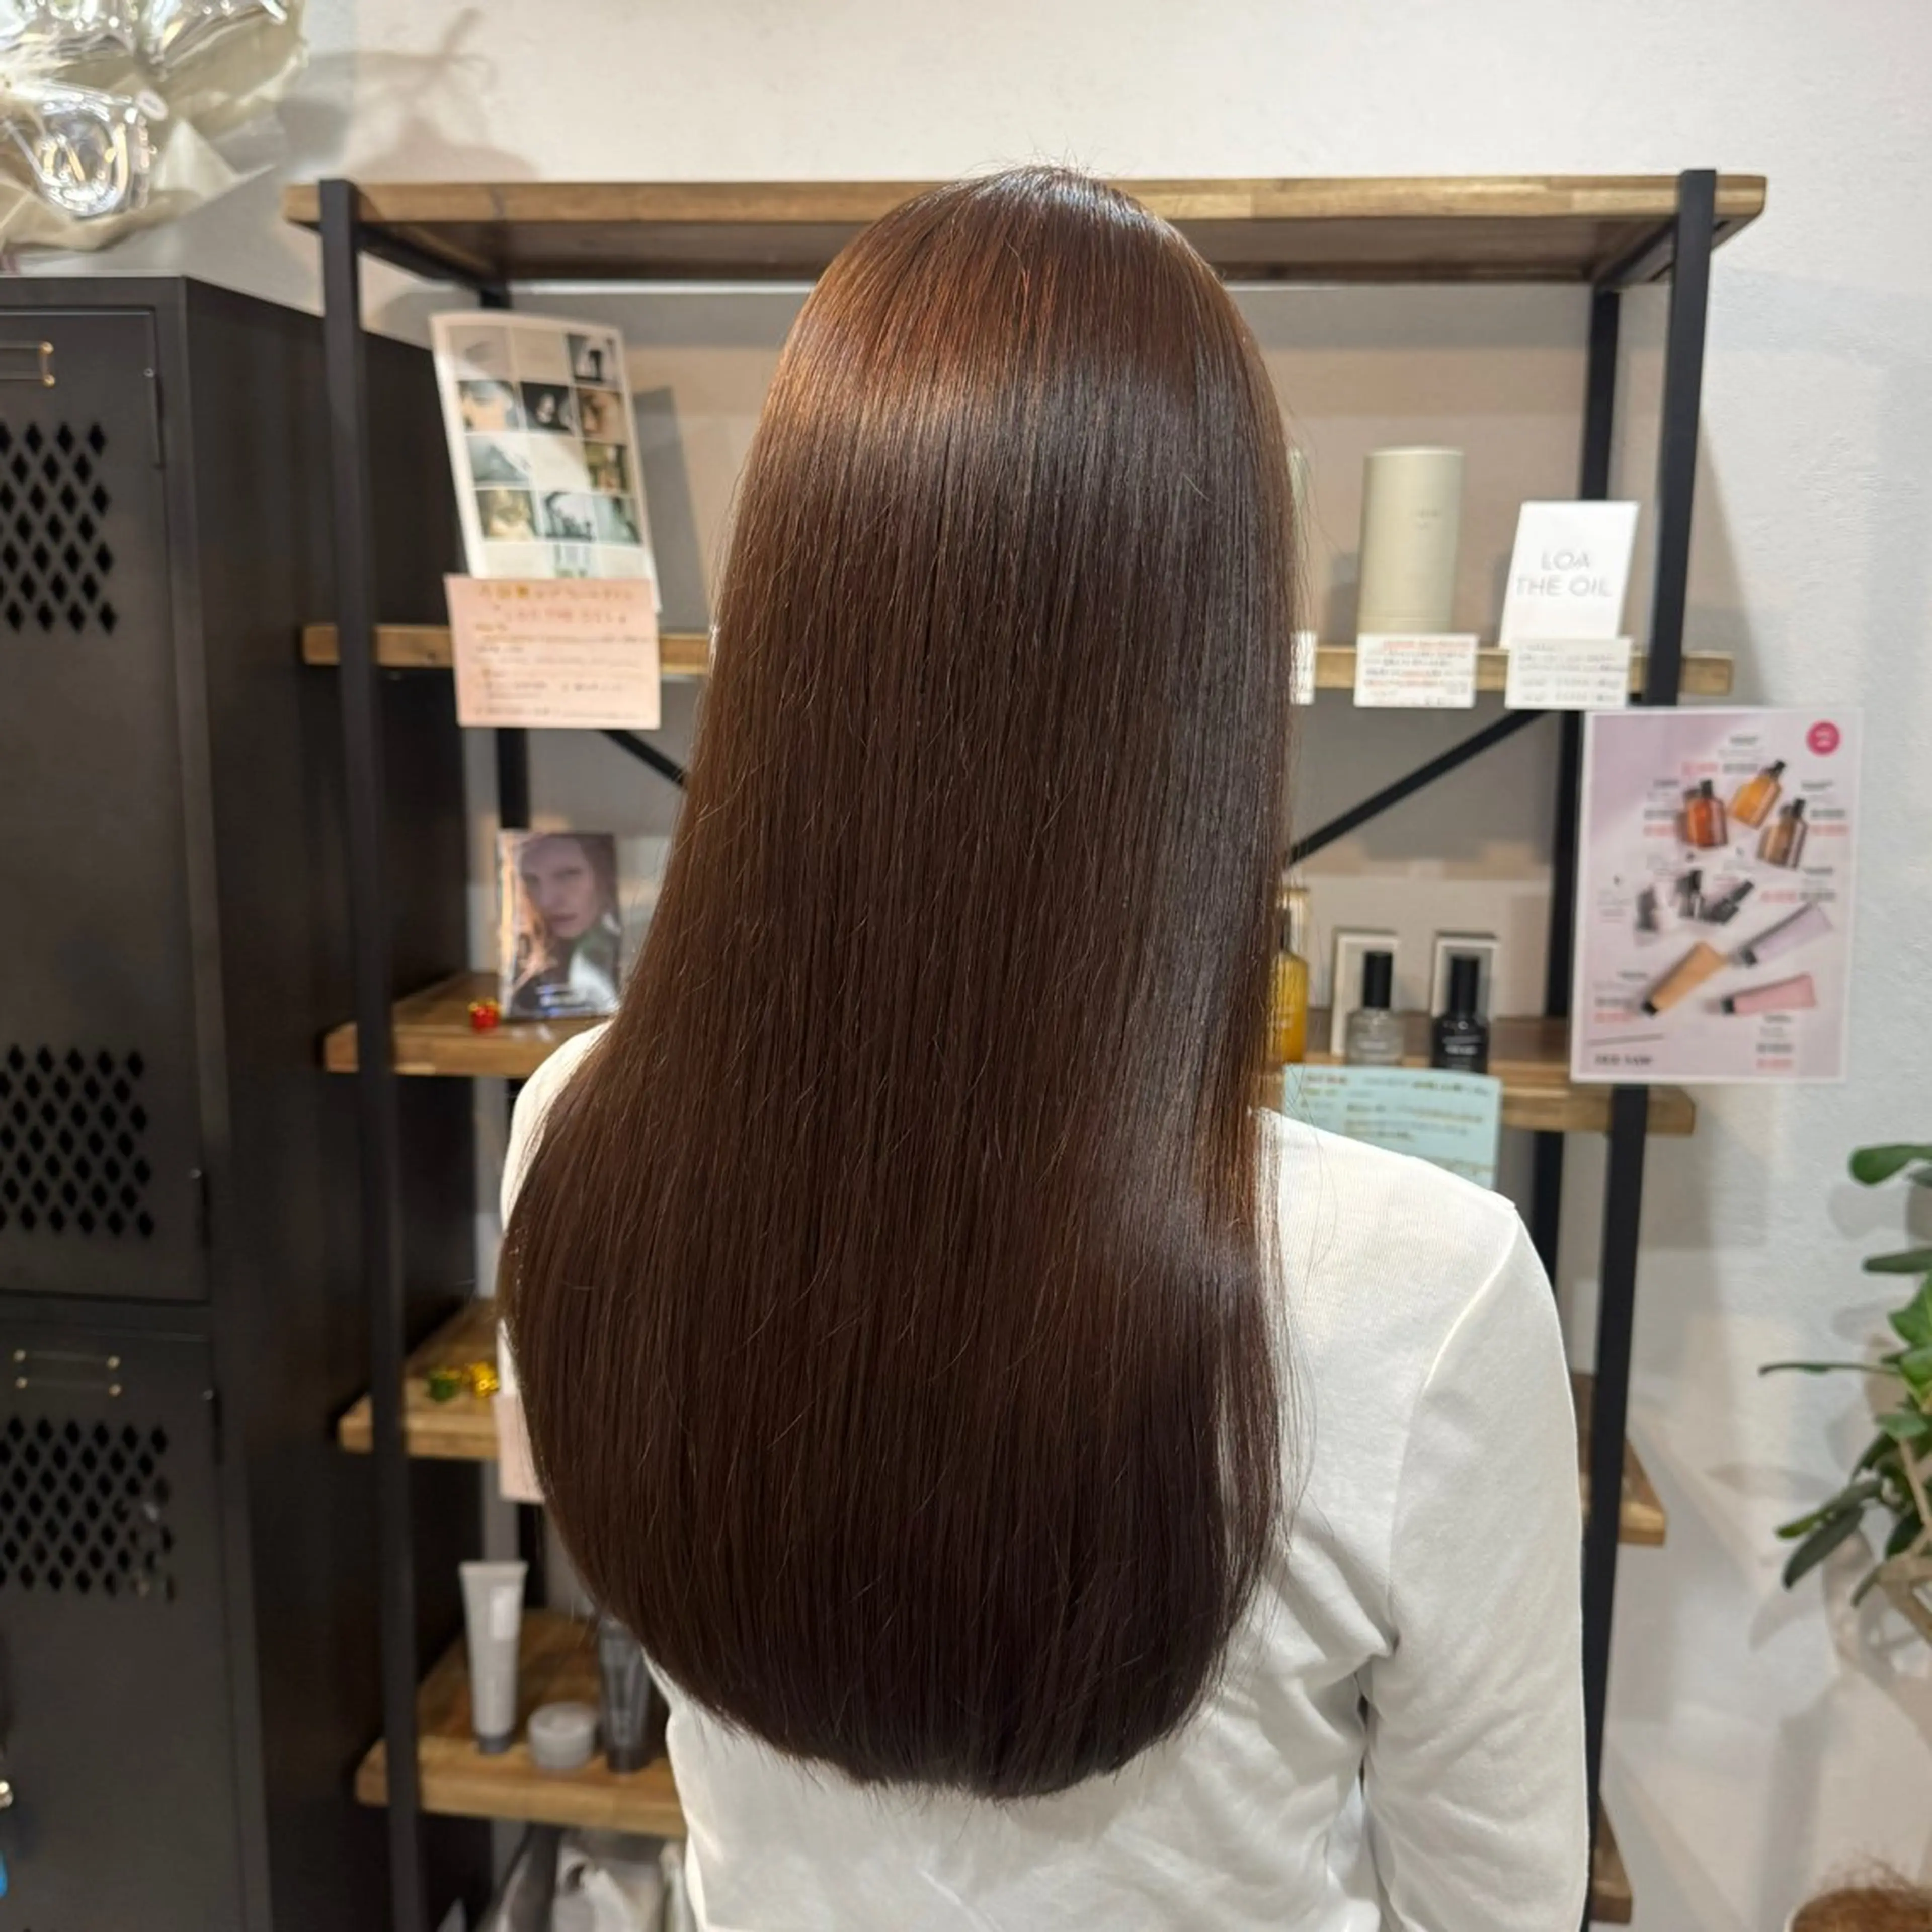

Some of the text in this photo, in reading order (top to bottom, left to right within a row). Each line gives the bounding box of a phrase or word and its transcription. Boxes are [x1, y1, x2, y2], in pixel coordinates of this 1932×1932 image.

[1541, 551, 1590, 571] LOA
[1516, 576, 1612, 597] THE OIL
